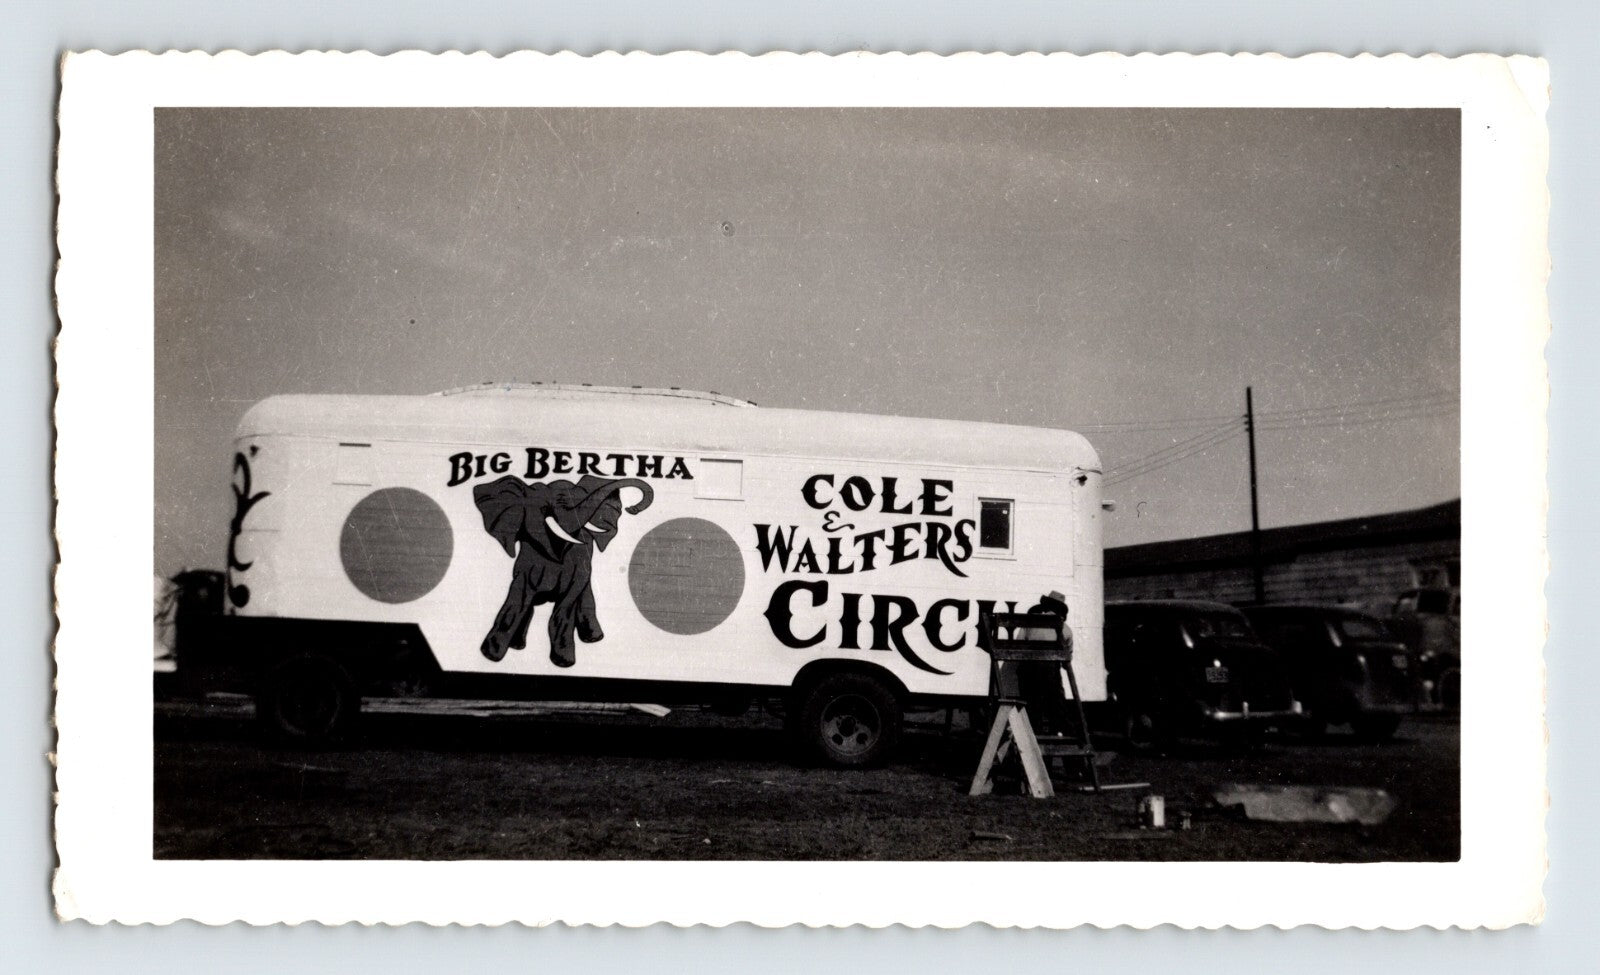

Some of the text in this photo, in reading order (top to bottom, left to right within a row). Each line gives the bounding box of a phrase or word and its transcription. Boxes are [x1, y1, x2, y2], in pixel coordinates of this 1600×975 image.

[447, 448, 694, 487] BIG BERTHA
[801, 474, 954, 516] COLE
[822, 511, 855, 532] &
[753, 519, 976, 577] WALTERS
[763, 580, 1060, 676] CIRCU
